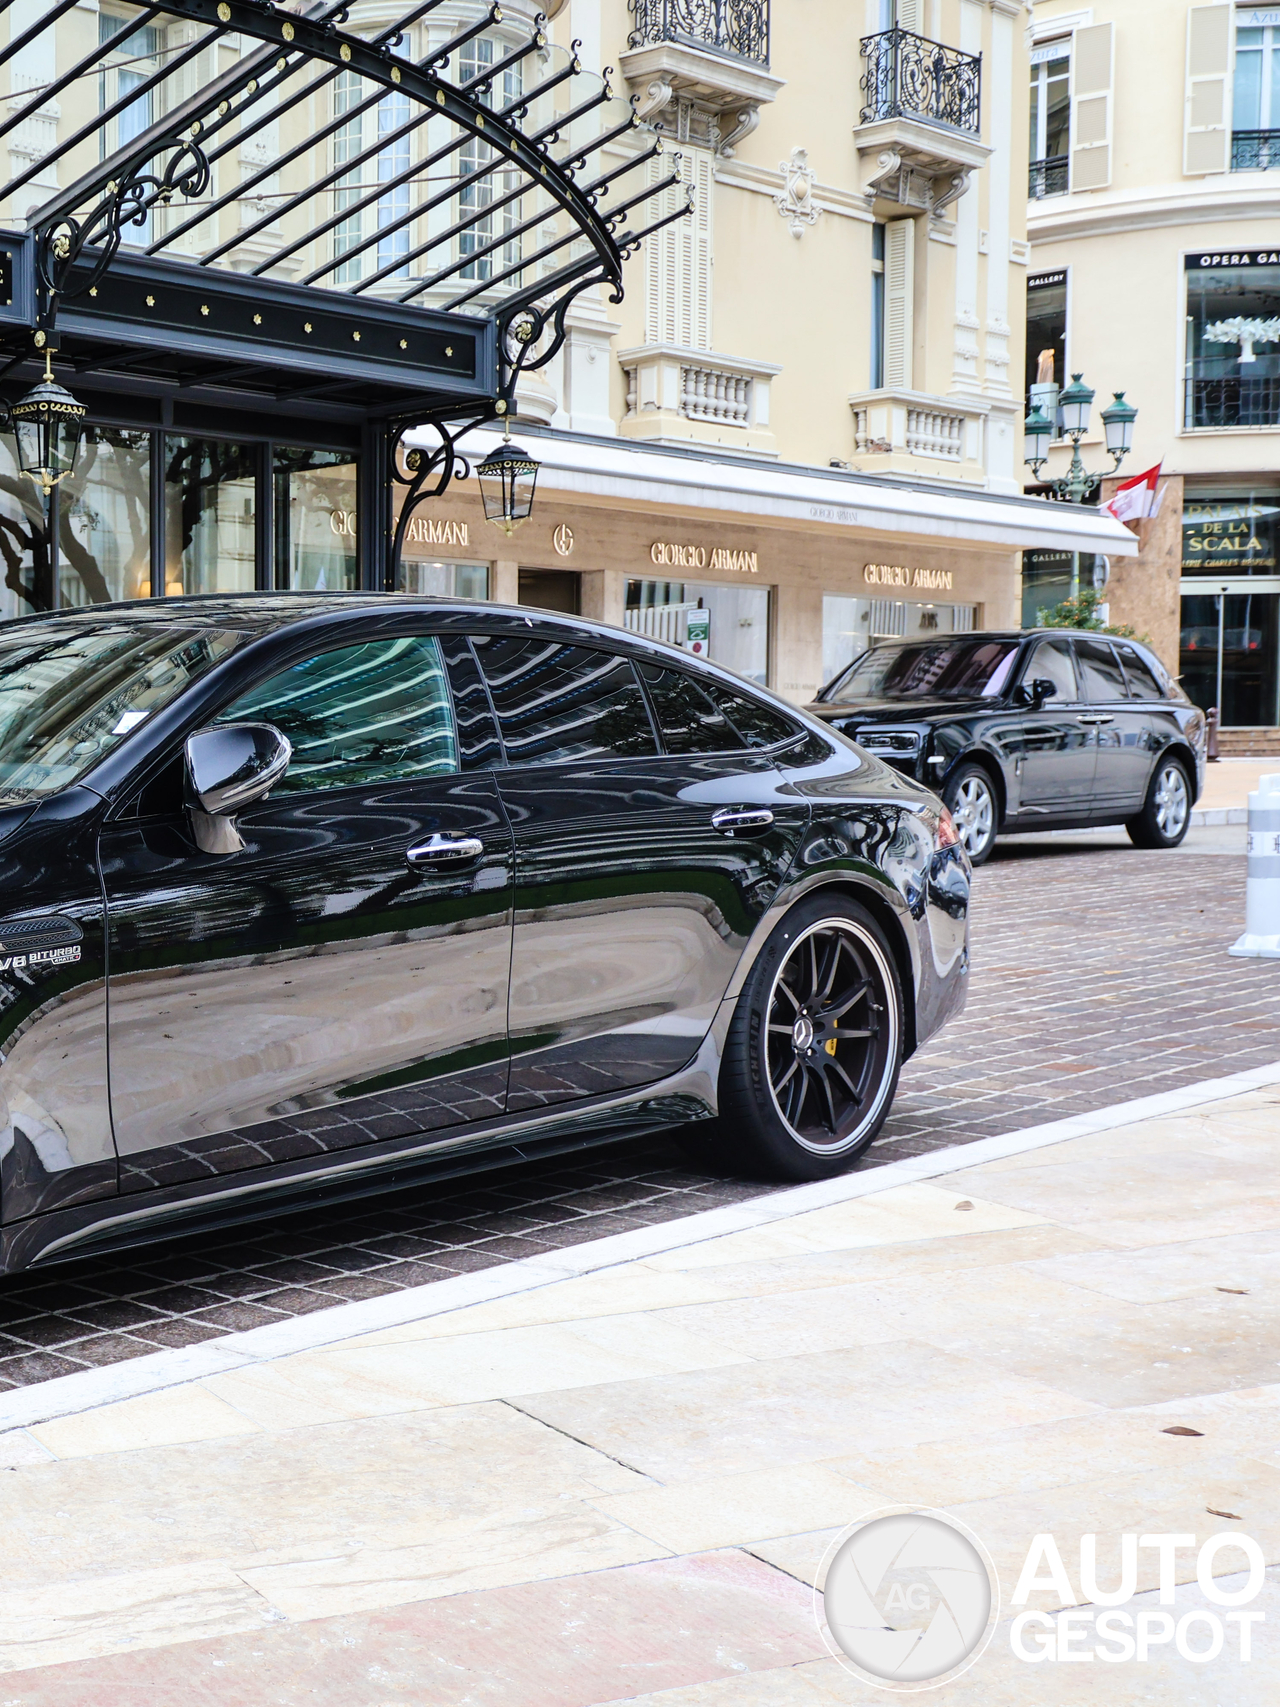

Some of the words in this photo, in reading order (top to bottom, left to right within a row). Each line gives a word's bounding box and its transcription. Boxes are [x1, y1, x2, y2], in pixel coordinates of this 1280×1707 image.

[1249, 11, 1280, 24] Azu
[1200, 253, 1250, 267] OPERA
[1256, 251, 1280, 264] GA
[1028, 273, 1064, 287] GALLERY
[810, 507, 835, 521] GIORGIO
[836, 509, 858, 522] ARMANI
[1188, 503, 1263, 519] PALAIS
[406, 517, 470, 546] ARMANI
[1201, 522, 1223, 534] DE
[1228, 522, 1249, 533] LA
[1188, 536, 1263, 551] SCALA
[650, 542, 706, 568] GIORGIO
[708, 547, 759, 573] ARMANI
[1032, 551, 1073, 563] GALLERY
[863, 564, 910, 587] GIORGIO
[911, 568, 953, 590] ARMANI
[29, 945, 81, 961] BITURBO
[750, 1013, 764, 1105] MICHELIN
